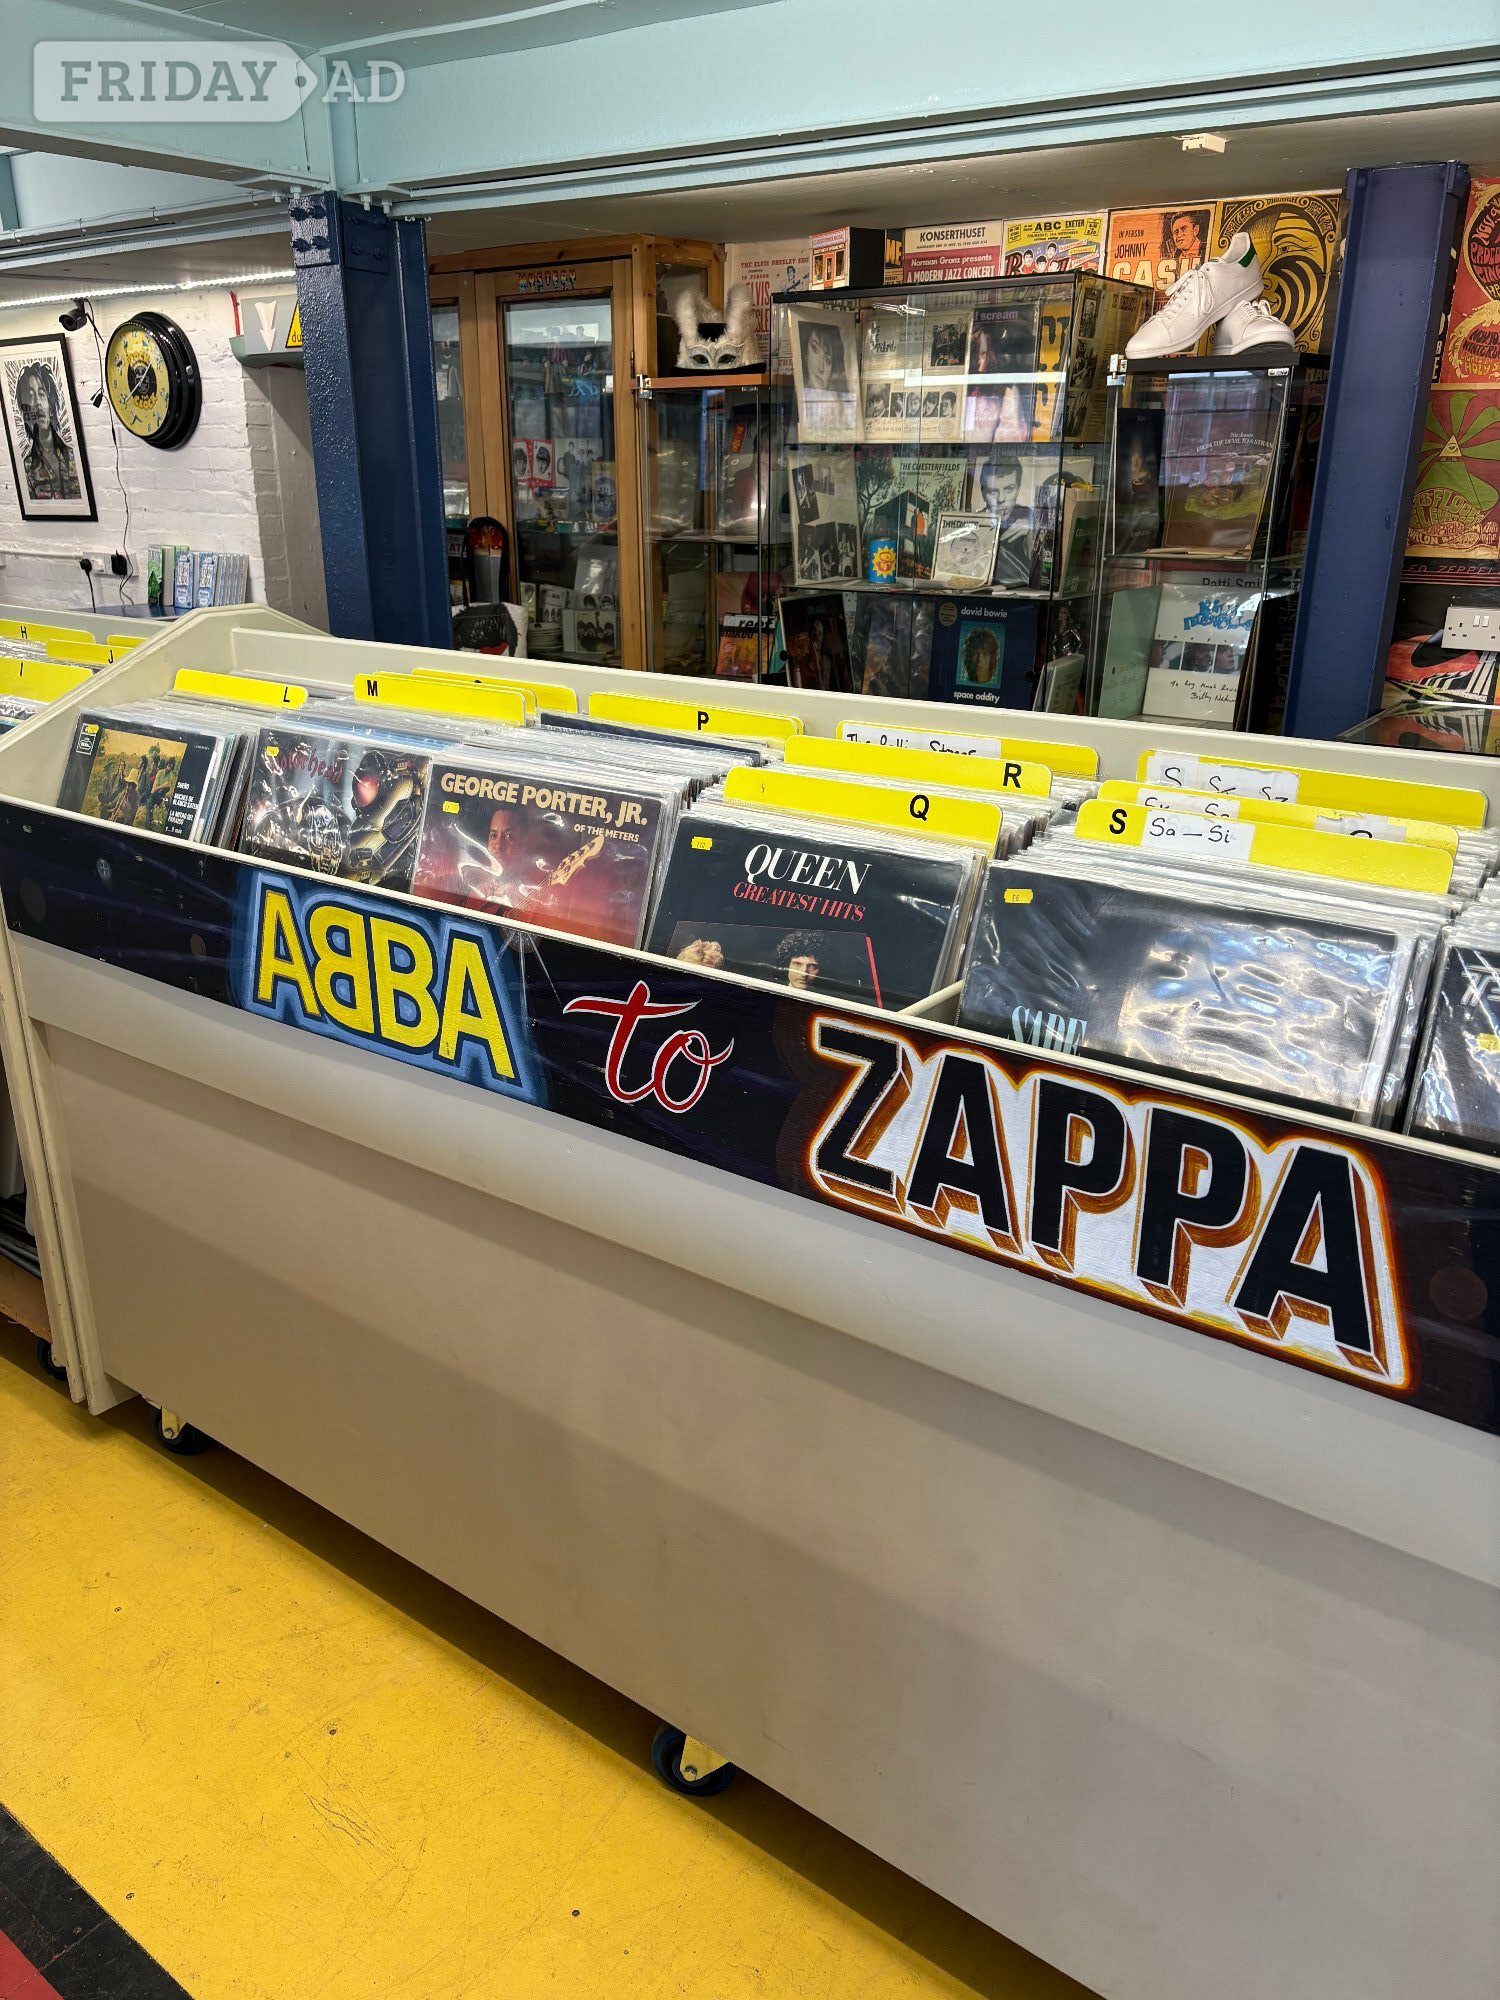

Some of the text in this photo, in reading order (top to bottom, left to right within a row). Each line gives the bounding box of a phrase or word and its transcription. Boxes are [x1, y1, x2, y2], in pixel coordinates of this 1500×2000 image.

[1034, 221, 1062, 231] ABC
[1065, 219, 1085, 228] EXETER
[1118, 229, 1145, 238] IN PERSON
[920, 227, 986, 242] KONSERTHUSET
[1114, 243, 1148, 259] JOHNNY
[911, 253, 992, 267] Norman Granz presents
[906, 271, 912, 283] A
[913, 269, 943, 282] MODERN
[944, 268, 961, 281] JAZZ
[963, 265, 995, 279] CONCERT
[980, 310, 1019, 321] scream
[900, 462, 961, 472] THE CHESTERFIELDS
[960, 606, 983, 617] david
[983, 607, 1008, 618] bowie
[740, 617, 775, 629] reef
[20, 625, 28, 639] H
[107, 649, 114, 664] J
[283, 686, 290, 703] L
[366, 679, 379, 697] M
[953, 691, 1000, 704] space oddity
[697, 710, 710, 731] P
[1002, 762, 1022, 788] R
[440, 772, 648, 828] GEORGE PORTER, JR.
[909, 794, 930, 821] Q
[574, 823, 640, 843] OF THE METERS
[1109, 808, 1231, 843] S Sa Si
[744, 843, 872, 895] QUEEN
[733, 881, 866, 922] GREATEST HITS
[1011, 1005, 1088, 1057] SADE
[255, 888, 1388, 1374] ABBA to ZAPPA
